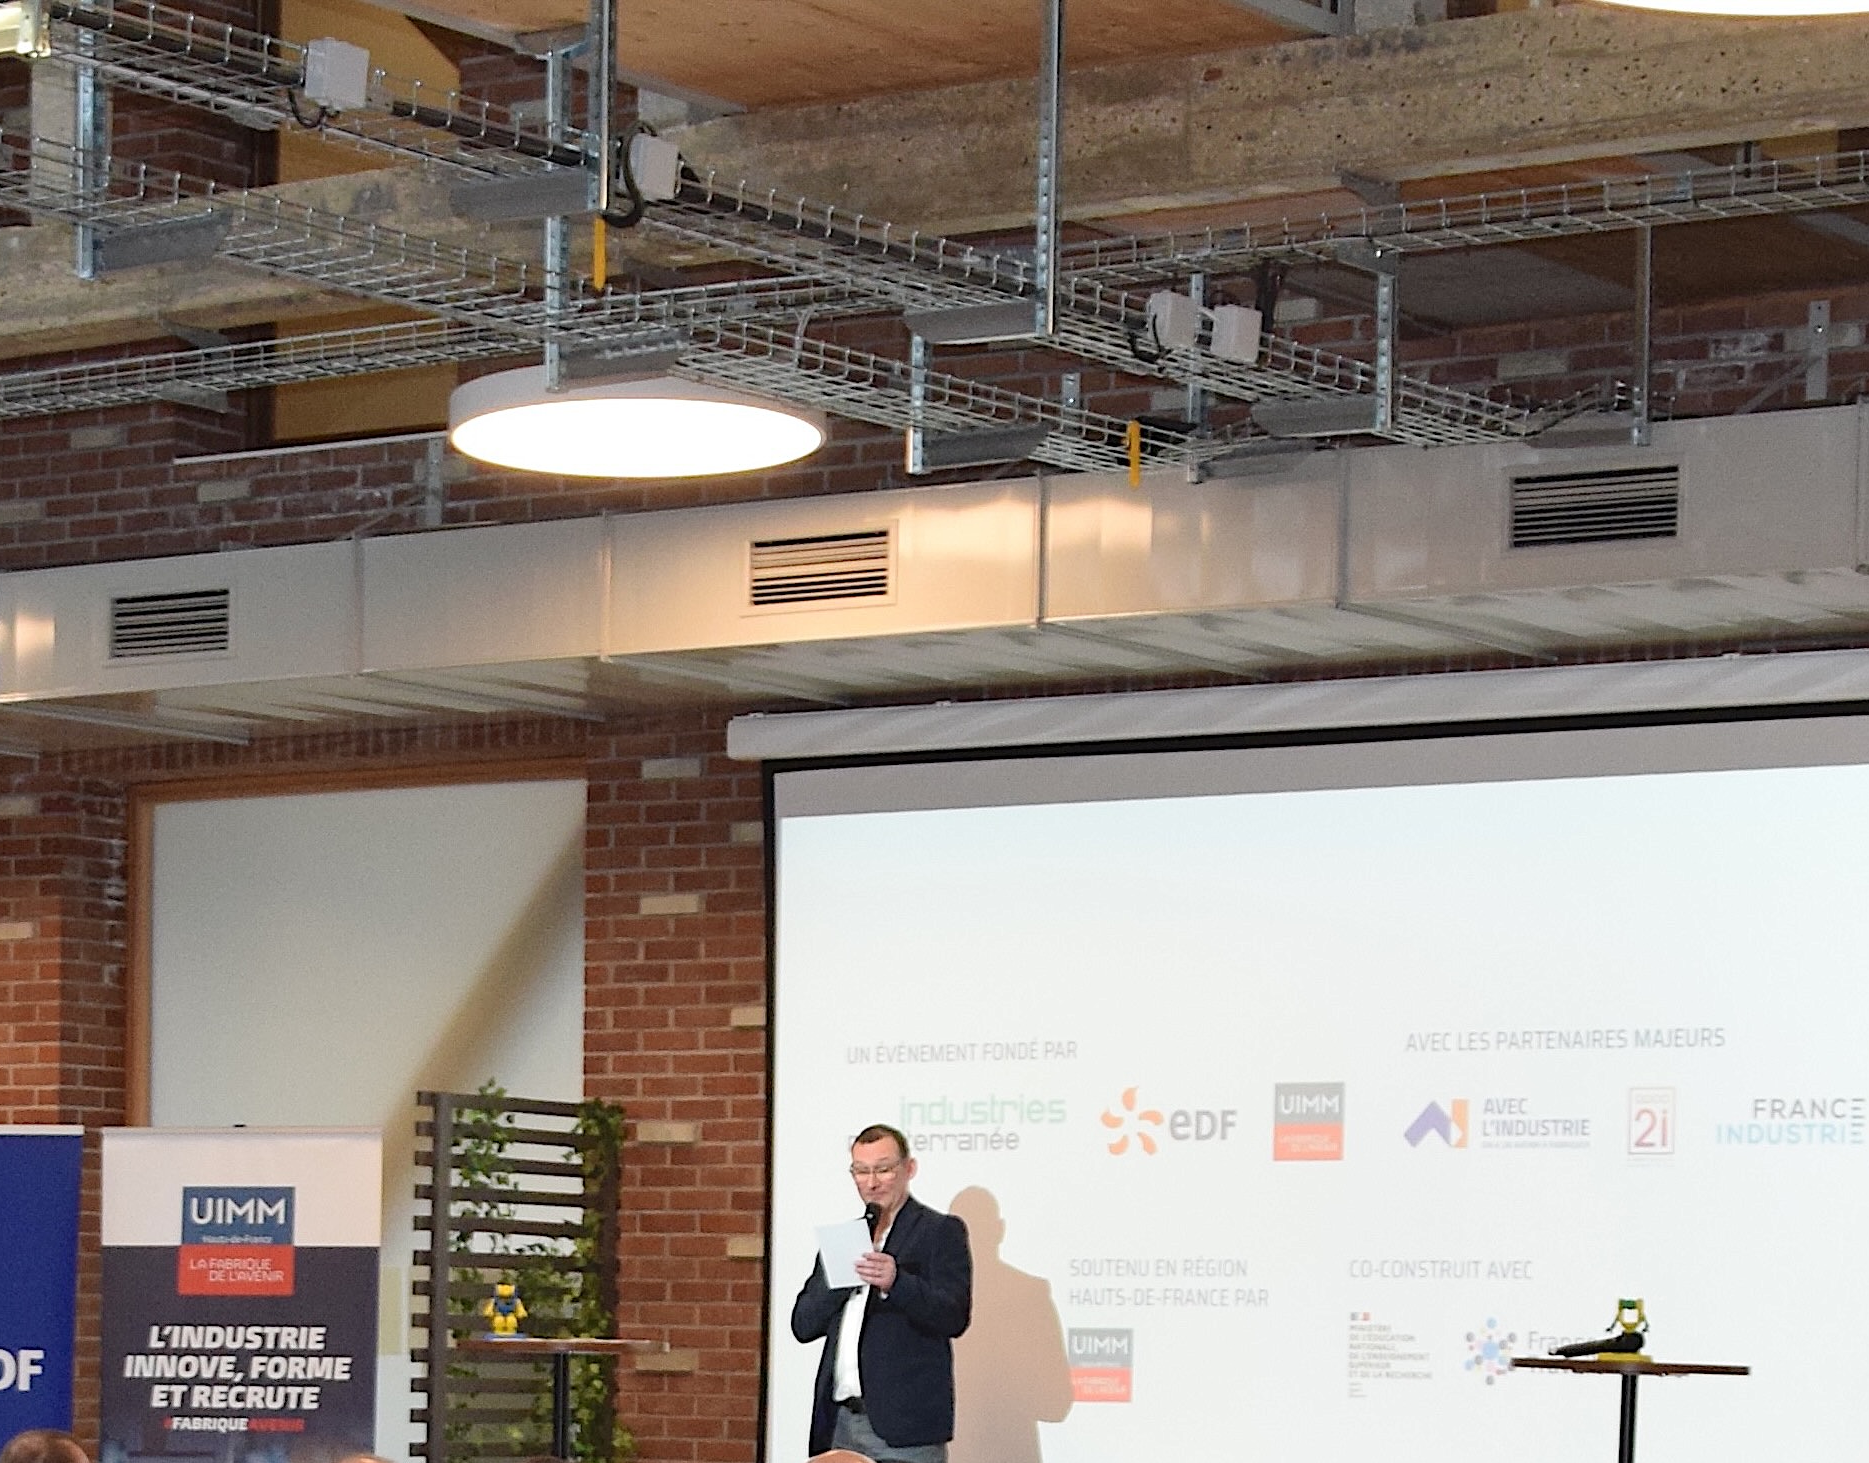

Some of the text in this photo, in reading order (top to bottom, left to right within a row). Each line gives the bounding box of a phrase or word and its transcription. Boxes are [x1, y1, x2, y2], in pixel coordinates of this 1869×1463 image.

[1405, 1028, 1726, 1052] AVEC LES PARTENAIRES MAJEURS
[847, 1040, 1078, 1064] UN ÉVÉNEMENT FONDÉ PAR
[901, 1094, 1068, 1128] industries
[1279, 1094, 1341, 1115] UIMM
[1483, 1097, 1529, 1115] AVEC
[1753, 1098, 1867, 1119] FRANCE
[1482, 1119, 1591, 1137] L'INDUSTRIE
[1633, 1107, 1669, 1148] 2i
[1716, 1122, 1866, 1145] INDUSTRIE
[190, 1197, 286, 1225] UIMM
[189, 1258, 273, 1271] LA FABRIQUE
[1069, 1256, 1248, 1277] SOUTENU EN RÉGION
[1349, 1260, 1533, 1279] CO-CONSTRUIT AVEC
[208, 1270, 228, 1282] DE
[1069, 1288, 1270, 1307] HAUTS-DE-FRANCE PAR
[148, 1324, 327, 1350] L'INDUSTRIE
[1072, 1335, 1129, 1354] UIMM
[124, 1355, 353, 1383] INNOVE, FORME
[151, 1384, 321, 1410] ET RECRUTE
